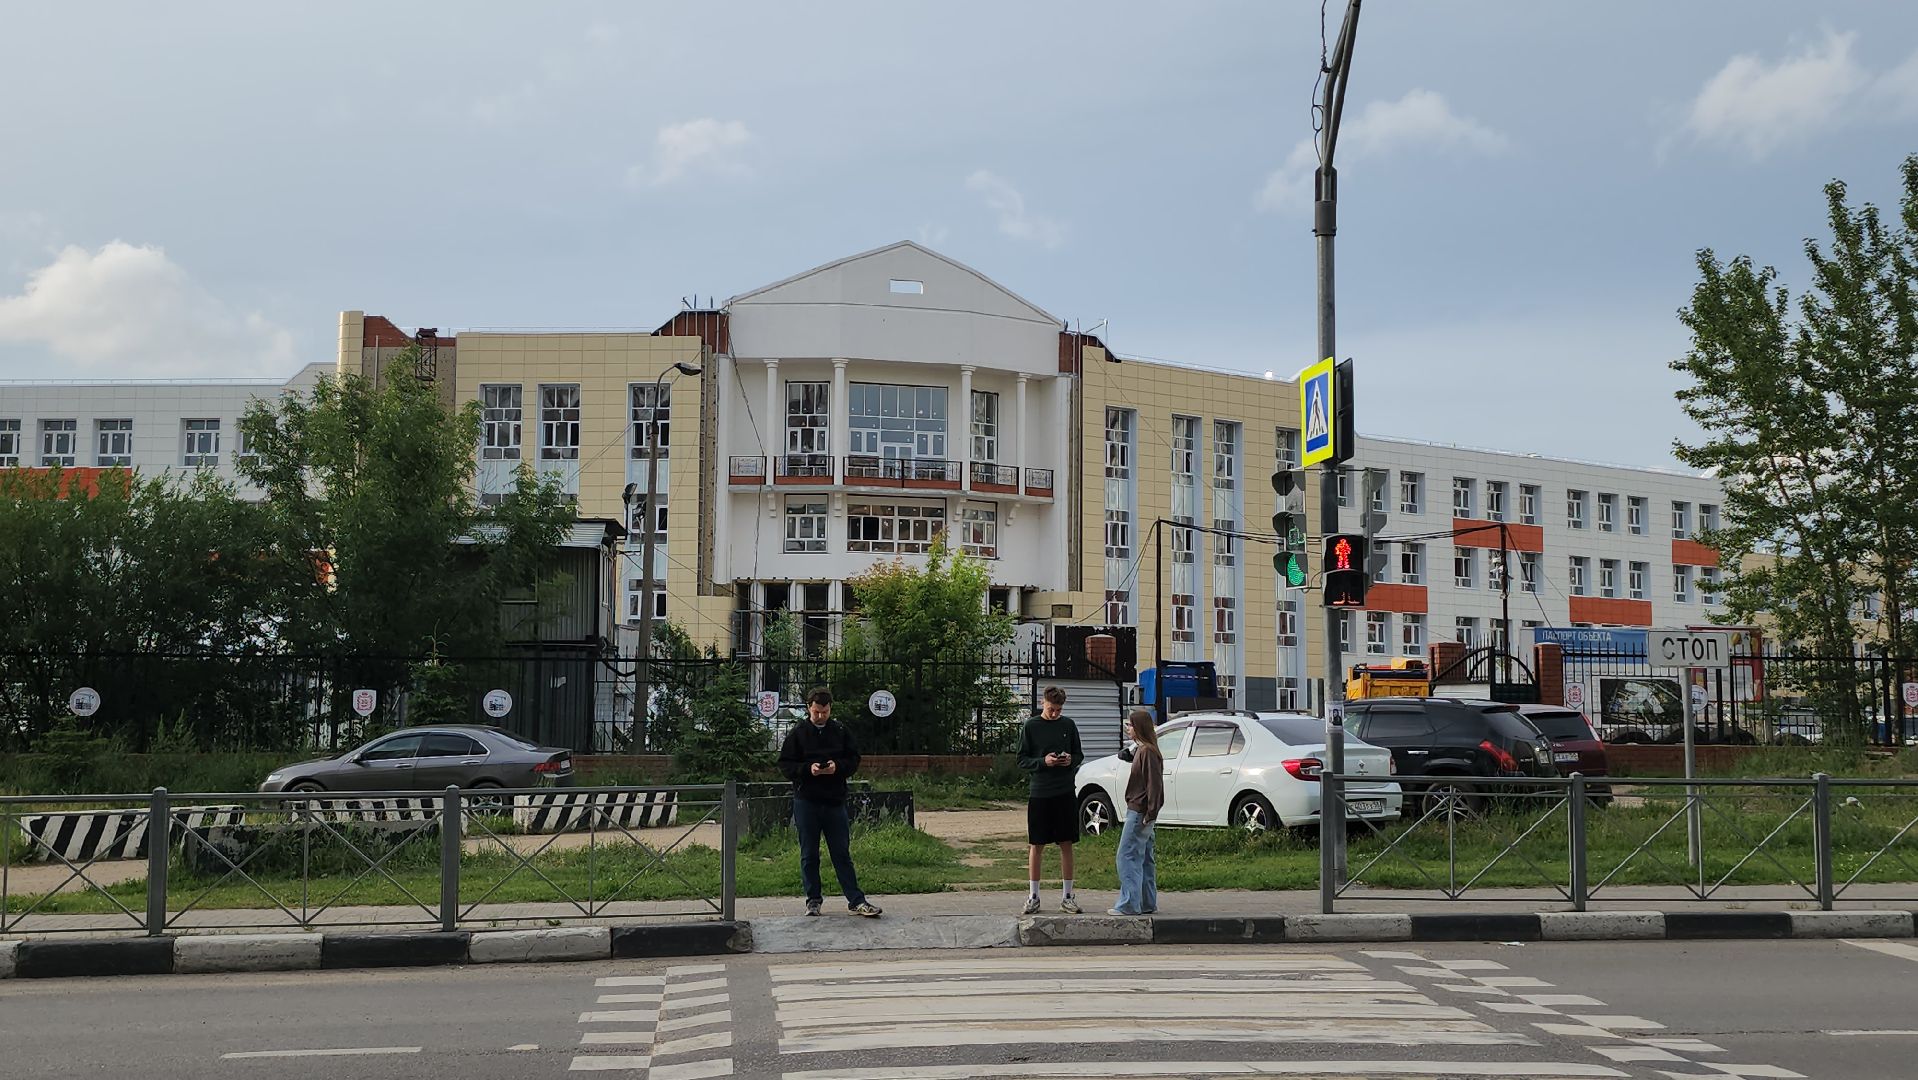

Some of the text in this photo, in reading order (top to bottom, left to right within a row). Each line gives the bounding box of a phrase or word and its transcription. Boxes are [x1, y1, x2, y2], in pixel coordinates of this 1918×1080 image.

[1542, 630, 1612, 641] ПАСПОРТ ОБЪЕКТА
[1662, 637, 1718, 660] СТОП
